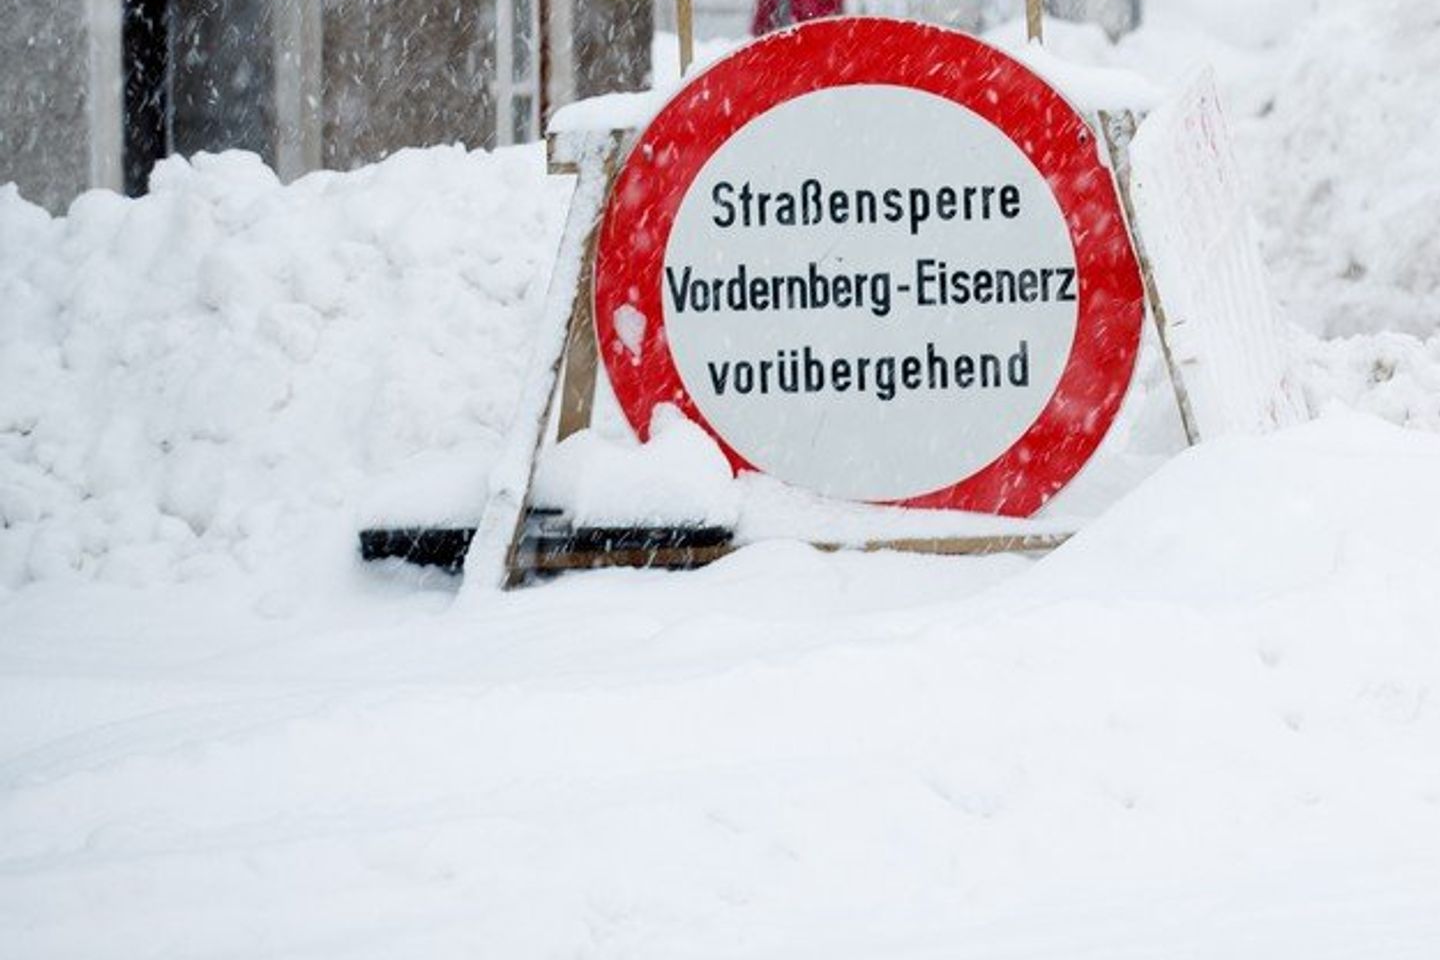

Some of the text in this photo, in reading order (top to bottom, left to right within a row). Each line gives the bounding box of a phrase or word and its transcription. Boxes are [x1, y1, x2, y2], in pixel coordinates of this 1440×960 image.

[712, 178, 1021, 234] Straßensperre
[666, 258, 1077, 317] Vordernberg-Eisenerz
[707, 340, 1030, 401] vorübergehend
